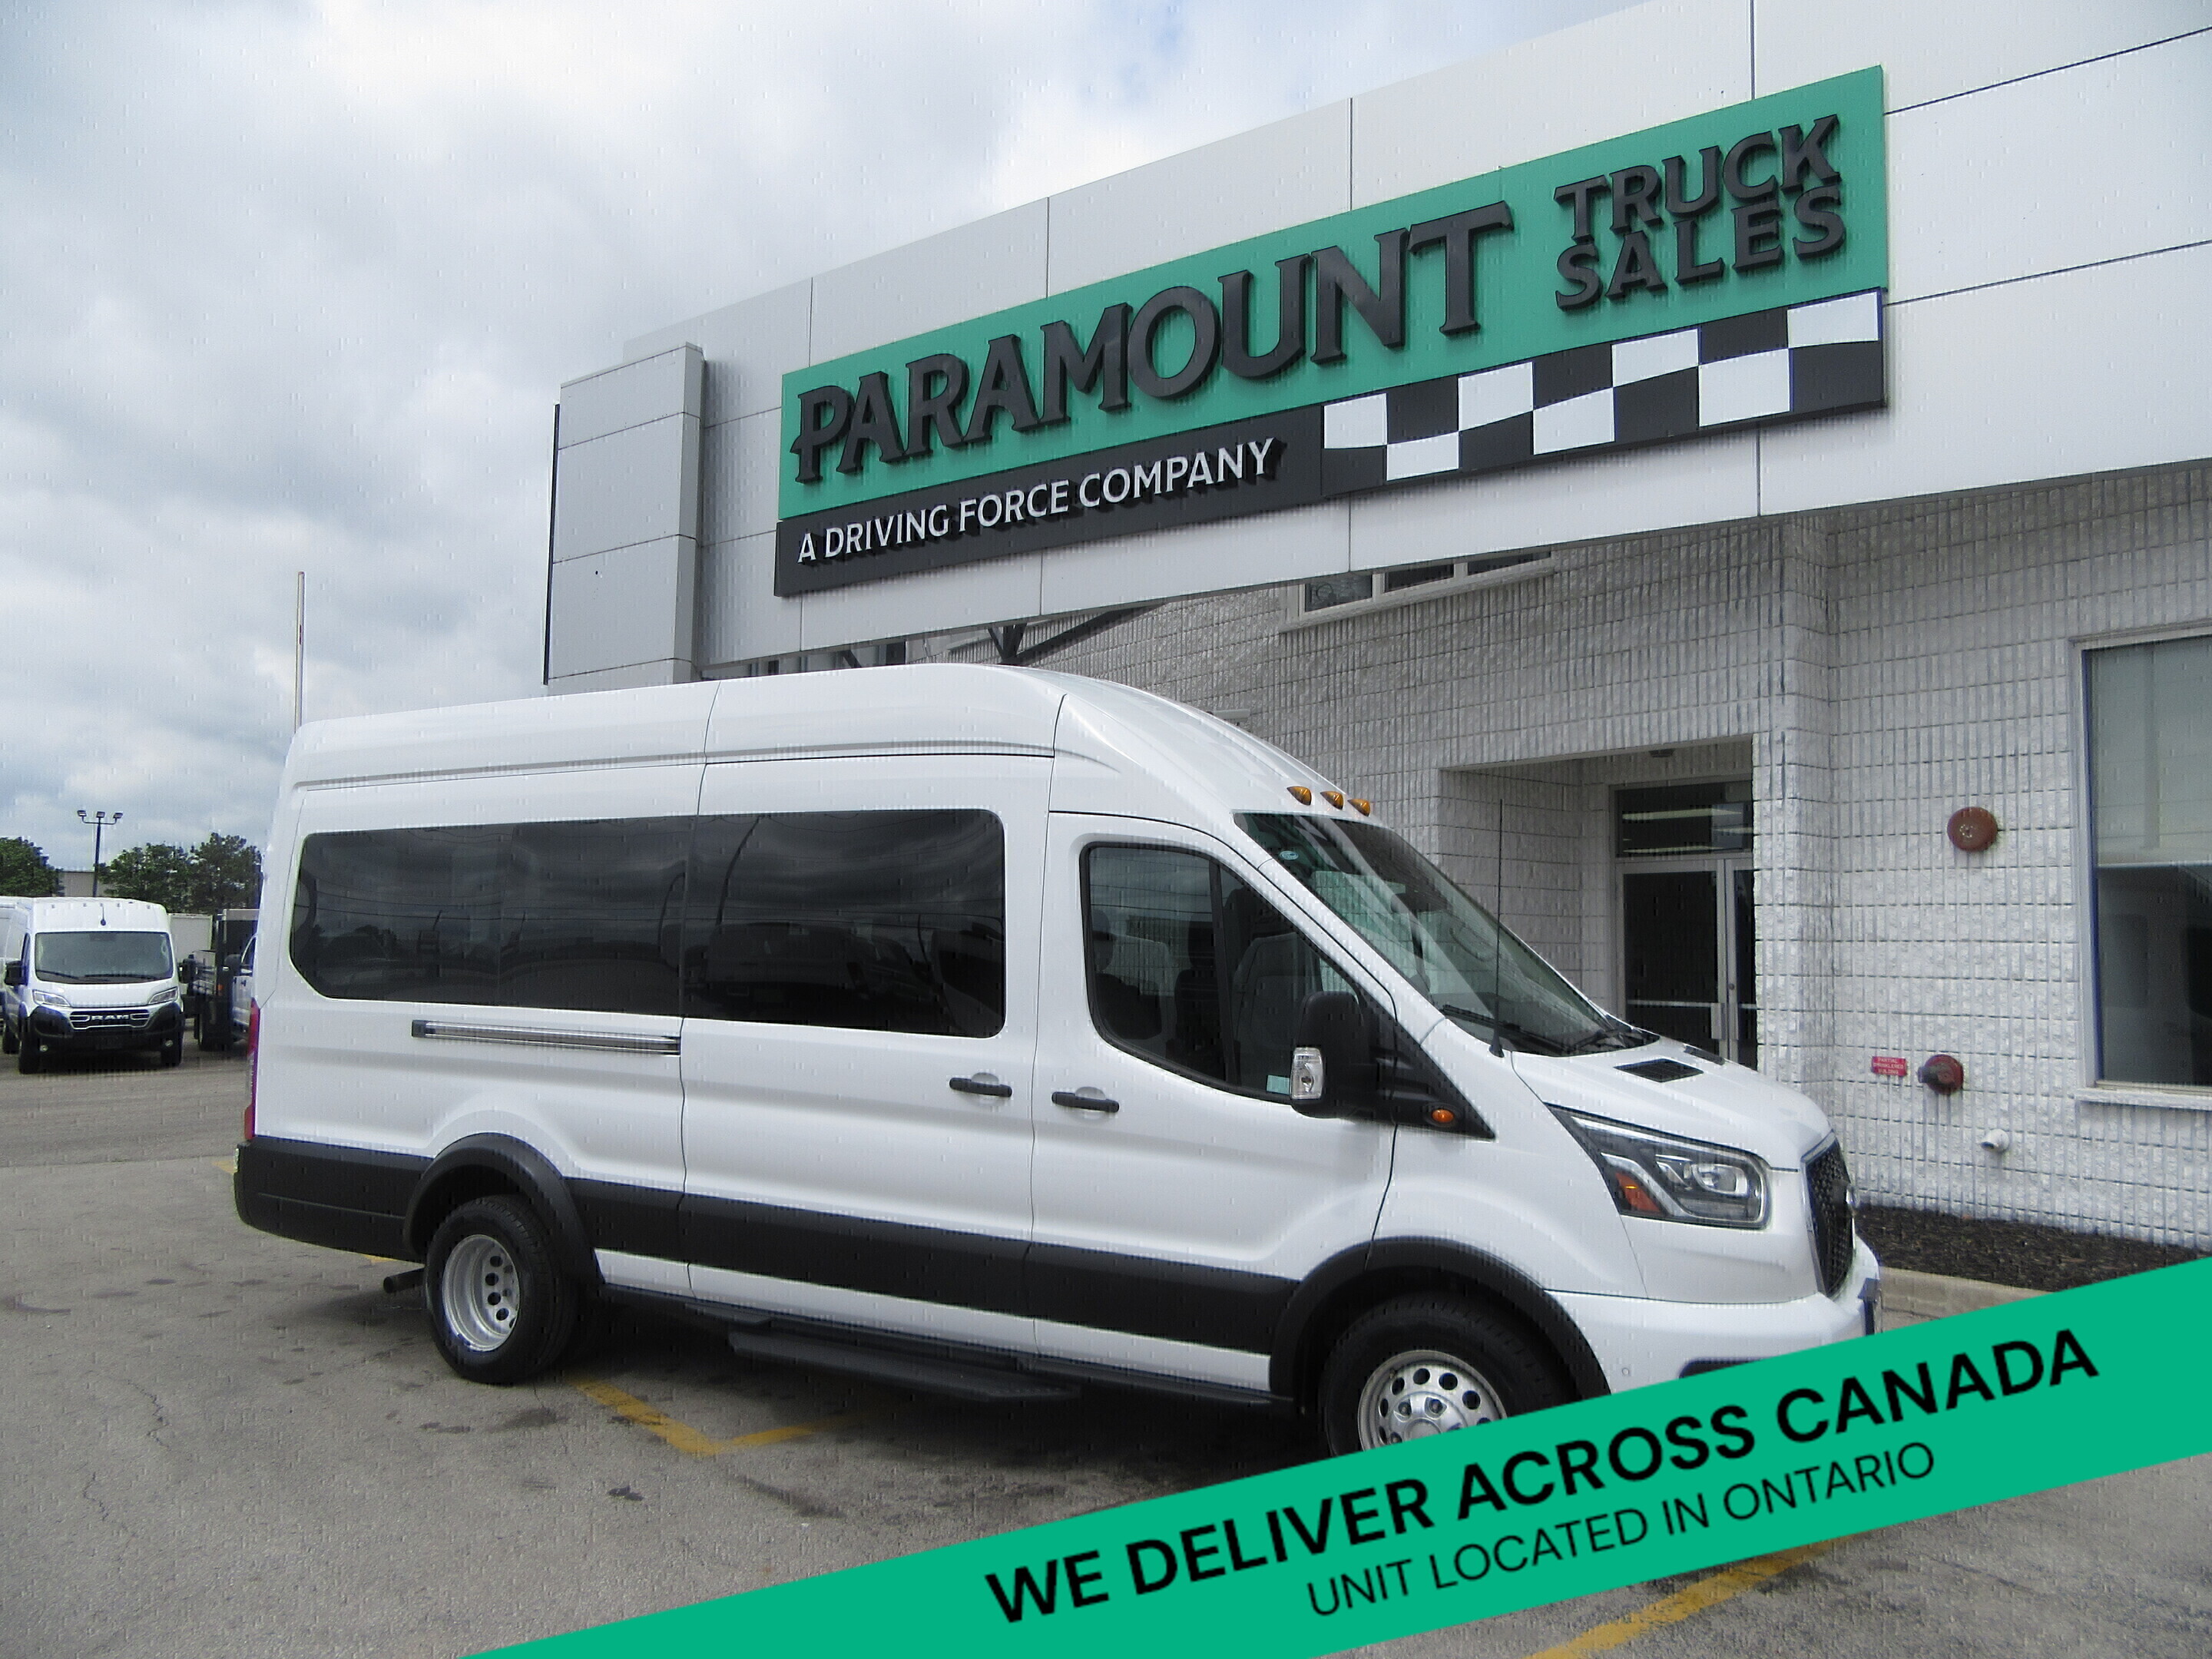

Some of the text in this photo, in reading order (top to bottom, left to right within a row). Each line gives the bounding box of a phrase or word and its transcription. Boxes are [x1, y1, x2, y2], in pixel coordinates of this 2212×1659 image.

[1553, 114, 1842, 243] TRUCK
[1555, 184, 1846, 312] SALES
[790, 200, 1515, 485] PARAMOUNT
[797, 437, 1277, 564] A DRIVING FORCE COMPANY
